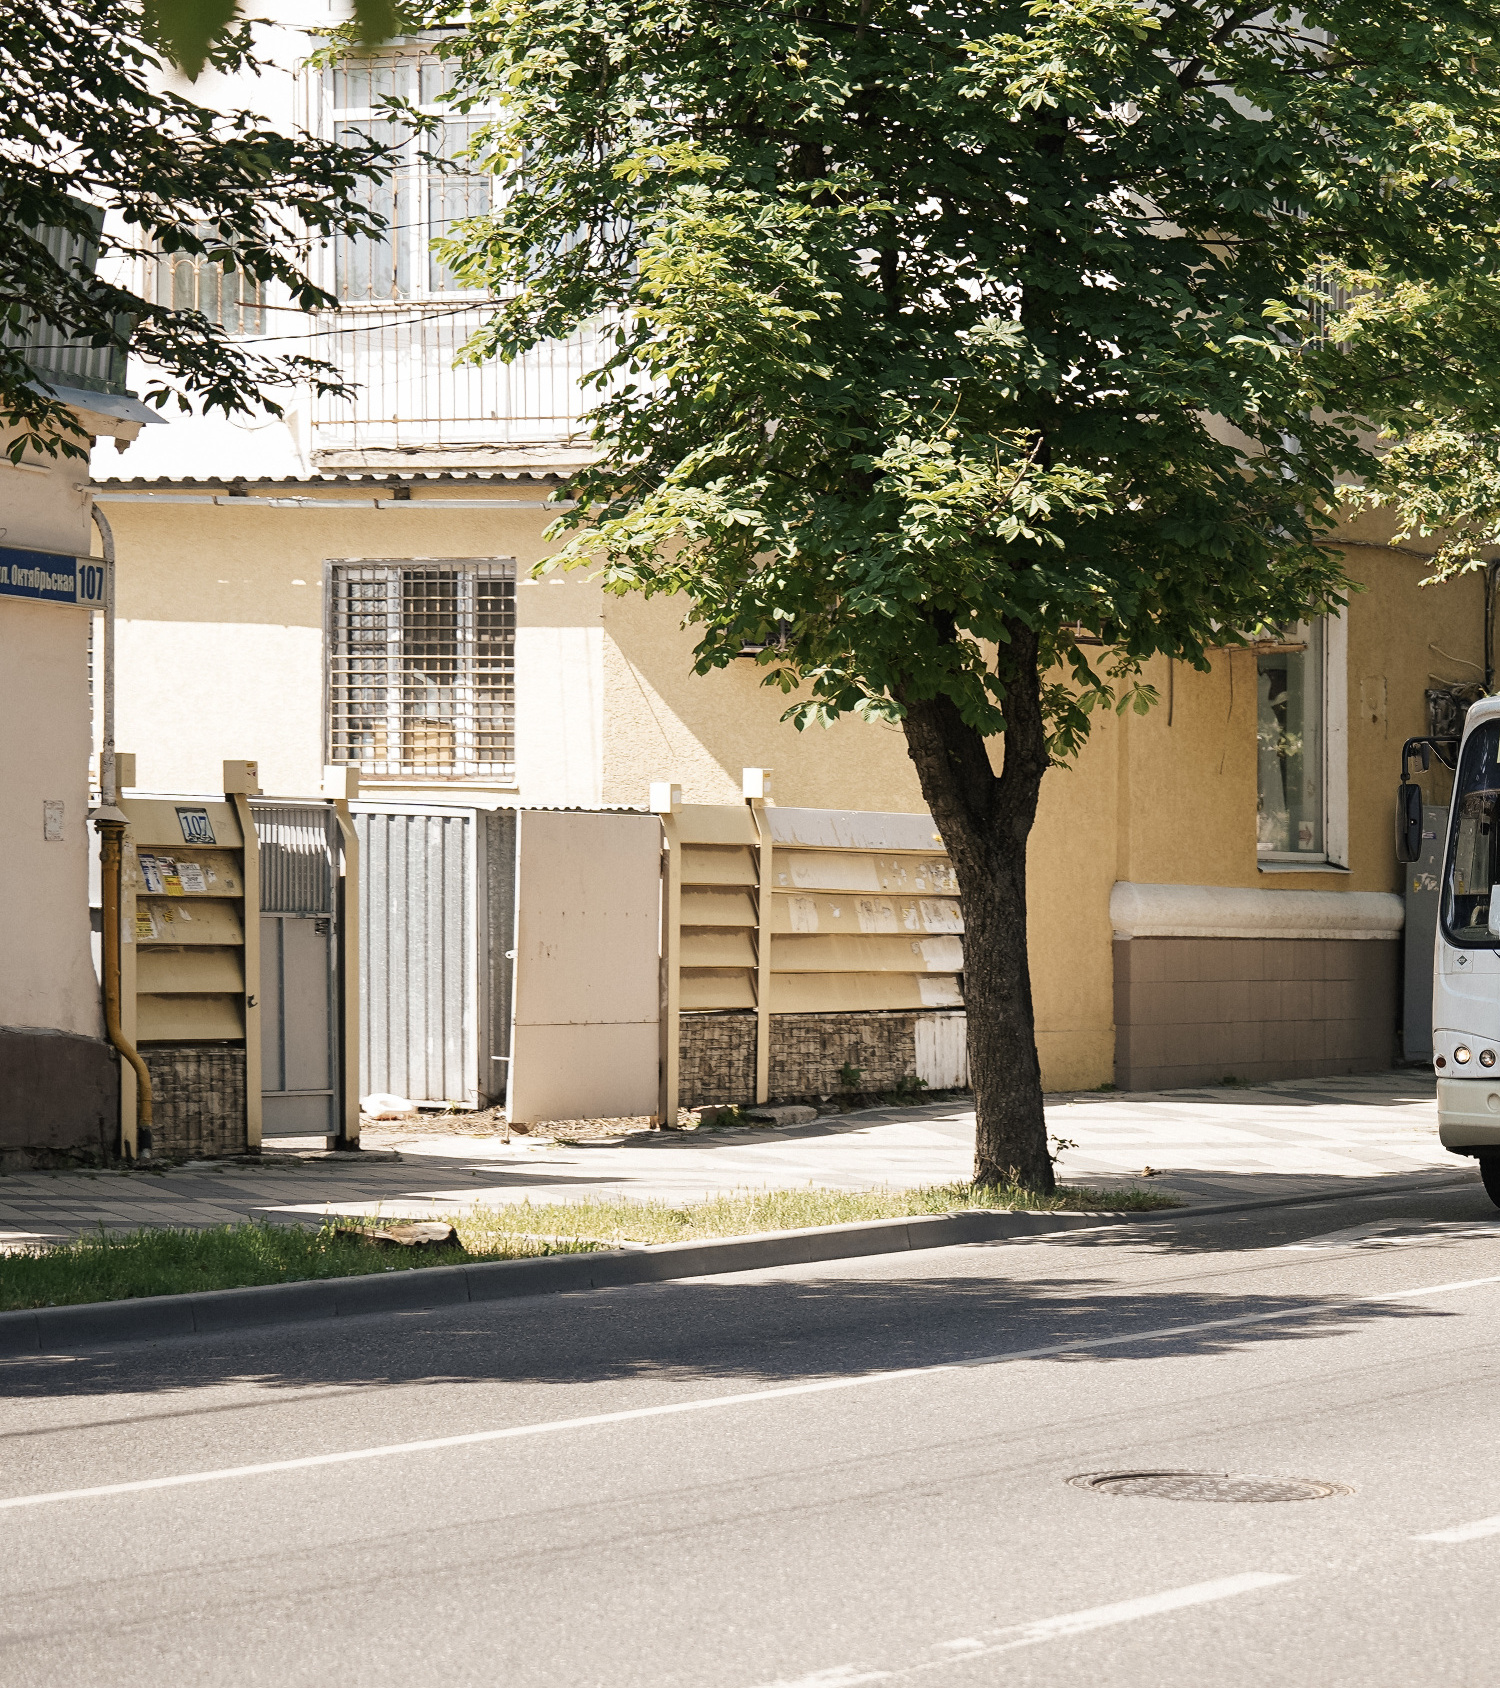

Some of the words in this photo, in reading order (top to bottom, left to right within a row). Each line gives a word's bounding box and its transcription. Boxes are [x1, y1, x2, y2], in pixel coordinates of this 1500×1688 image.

[12, 564, 74, 591] Октябрьская
[79, 565, 103, 600] 107
[182, 815, 208, 837] 107
